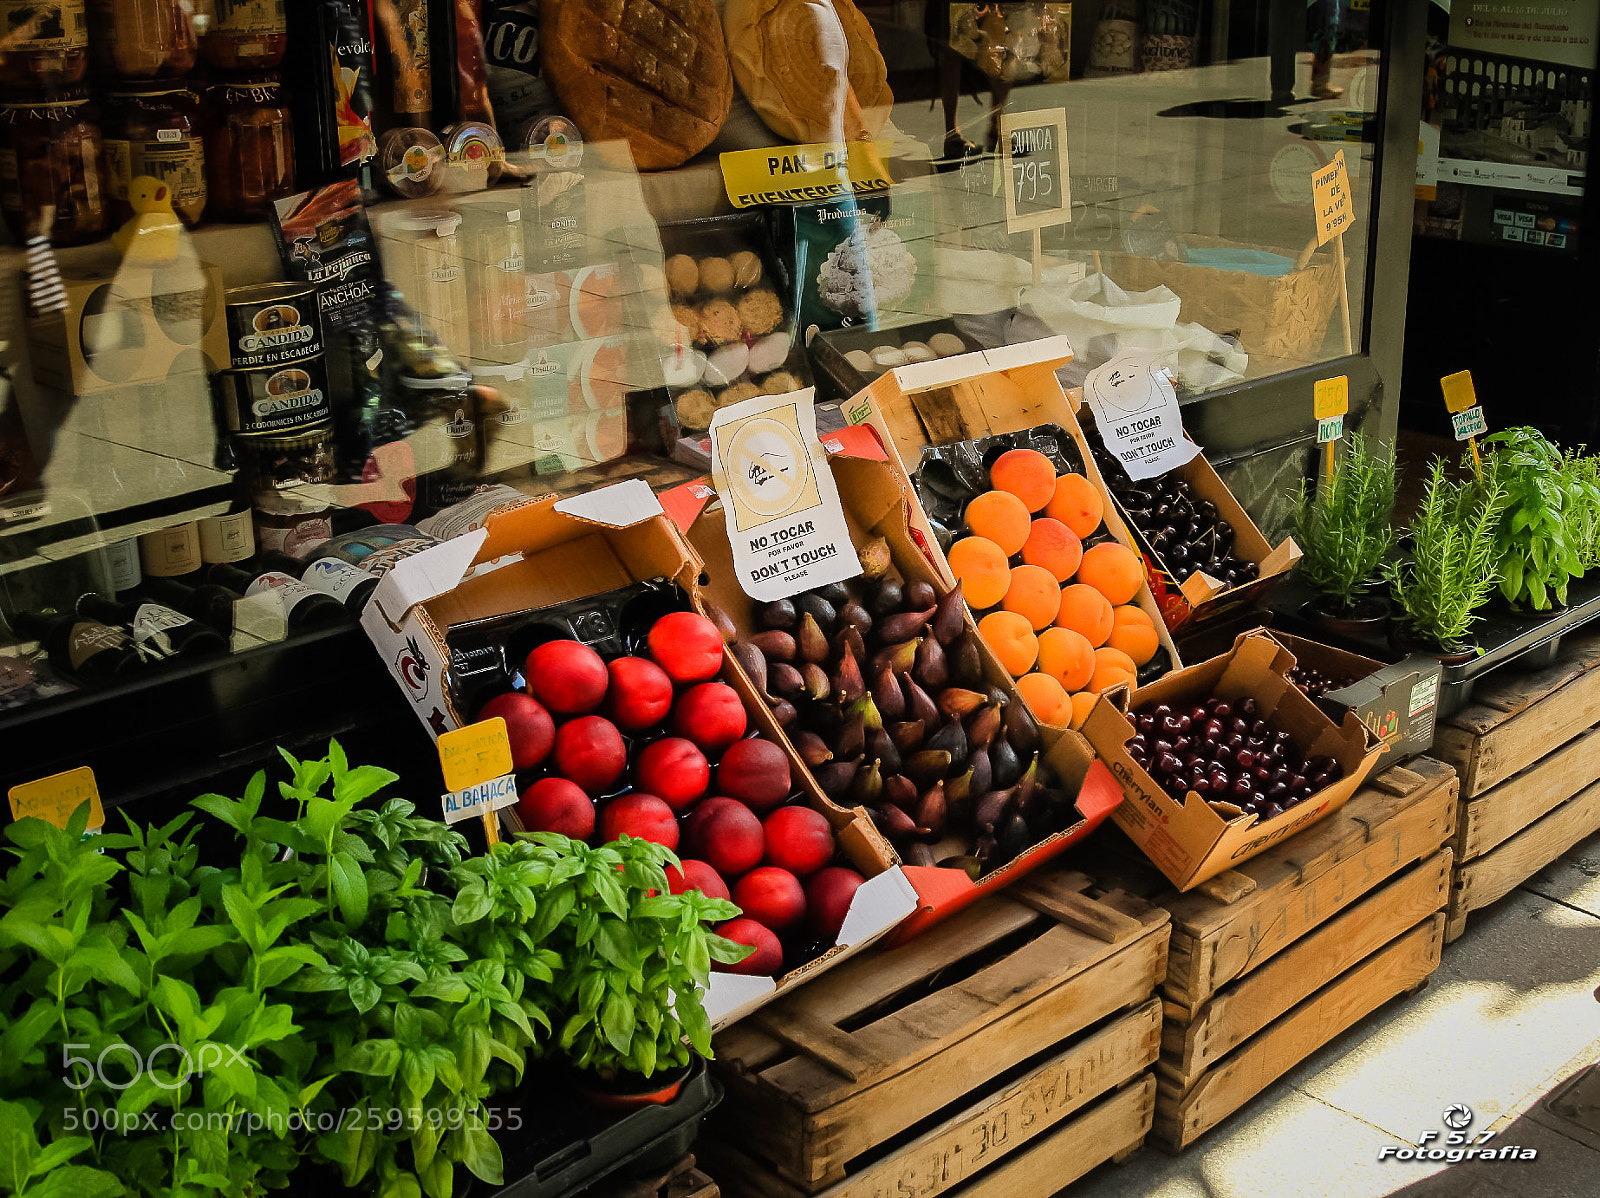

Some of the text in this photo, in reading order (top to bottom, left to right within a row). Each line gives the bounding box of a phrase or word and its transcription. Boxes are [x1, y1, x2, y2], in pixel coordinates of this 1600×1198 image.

[1010, 128, 1053, 155] QUINOA
[767, 154, 808, 176] PAN
[1331, 184, 1341, 197] DE
[817, 208, 867, 225] Productos
[1323, 206, 1334, 217] LA
[1518, 215, 1533, 223] VISA
[551, 219, 577, 229] BONITO
[244, 329, 310, 349] CANDIDA
[232, 355, 264, 366] PERDIZ
[266, 353, 279, 362] EN
[258, 393, 319, 413] CANDIDA
[251, 418, 294, 429] CODORNICES
[1115, 415, 1162, 438] NO TOCAR
[1120, 436, 1175, 461] DON'T TOUCH
[749, 520, 815, 551] NO TOCAR
[768, 540, 805, 558] POR FAVOR
[751, 542, 837, 582] DON'T TOUCH
[784, 569, 809, 583] PLEASE
[445, 777, 515, 813] ALBAHACA
[1112, 761, 1163, 817] Cherrylan
[1231, 806, 1321, 861] Cherrylan
